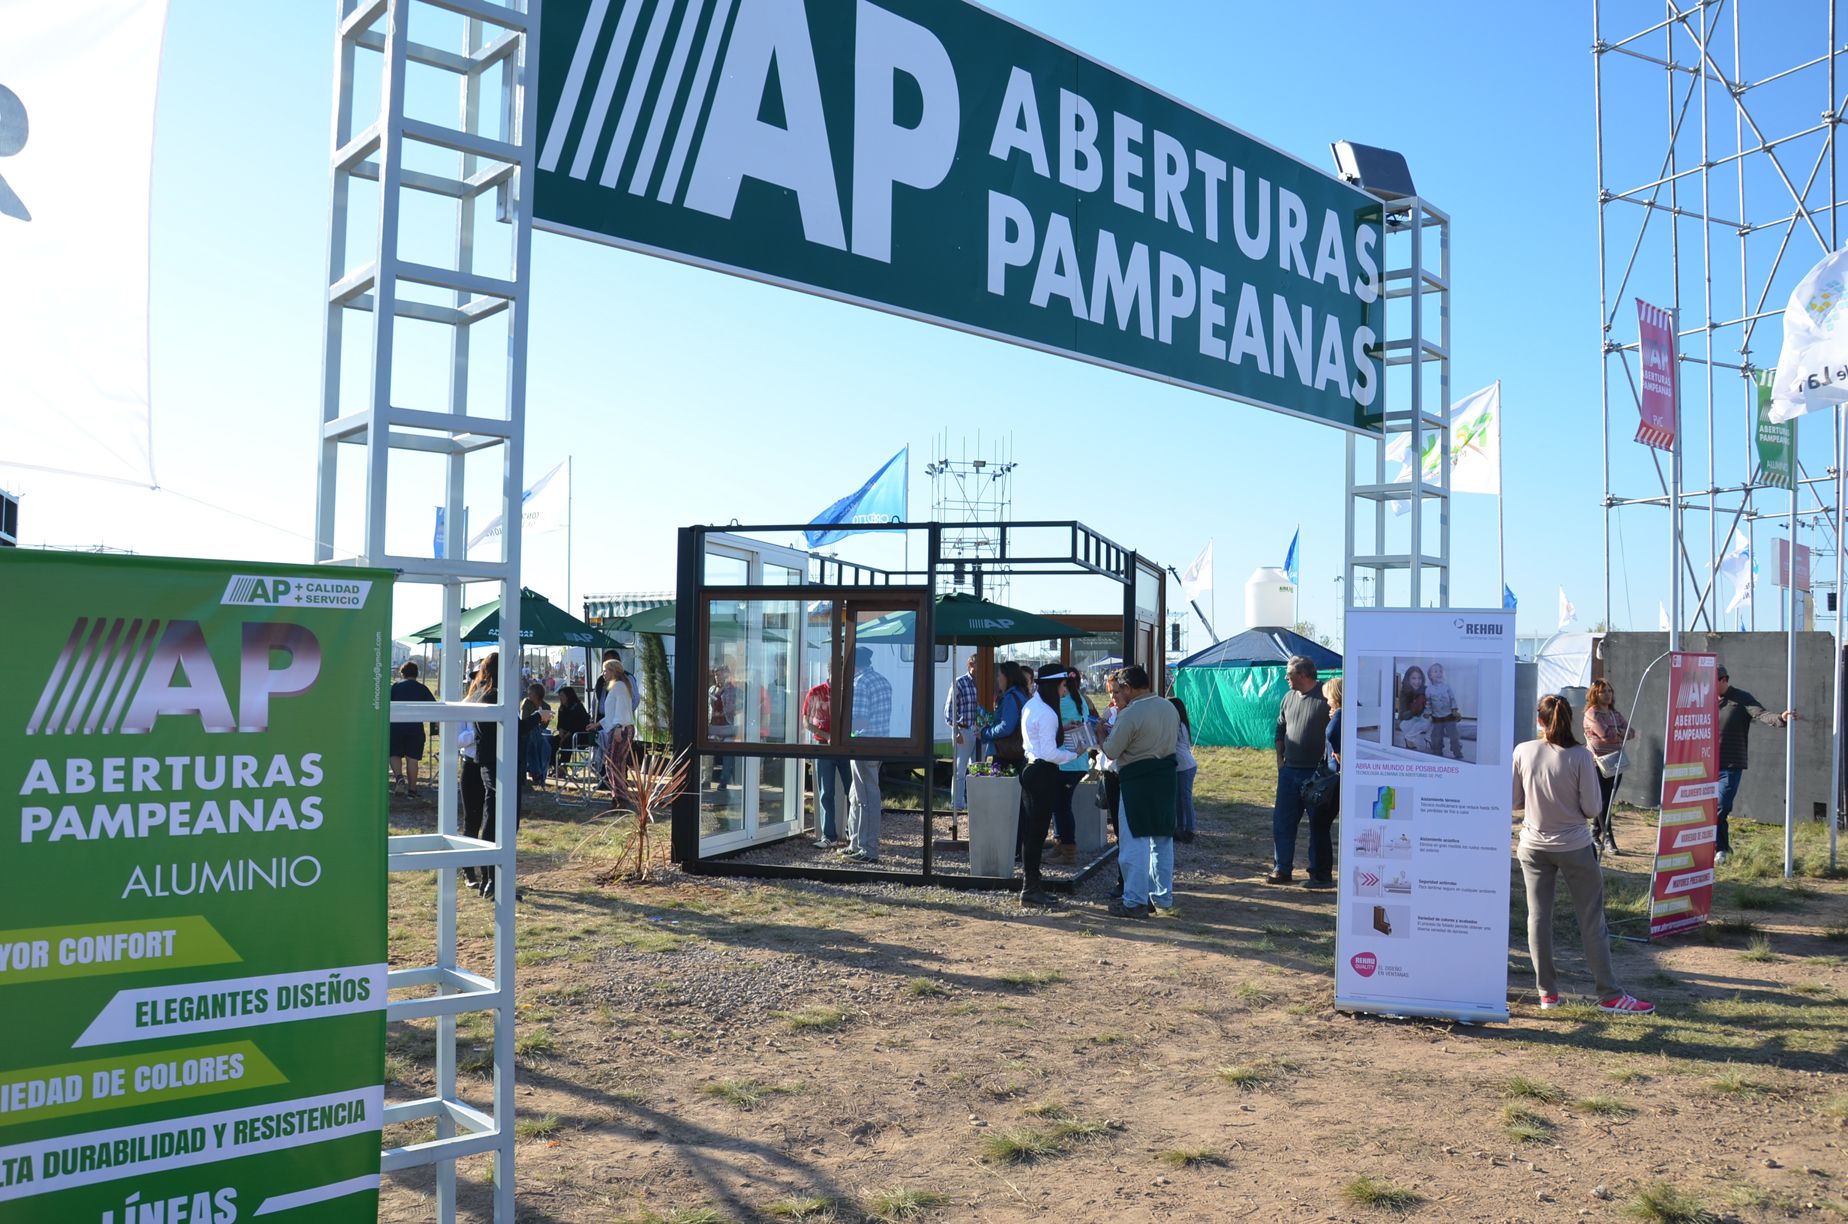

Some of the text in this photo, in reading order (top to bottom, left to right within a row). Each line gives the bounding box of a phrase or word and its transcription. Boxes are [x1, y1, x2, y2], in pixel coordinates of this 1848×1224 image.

[683, 0, 960, 264] AP
[989, 65, 1380, 304] ABERTURAS
[987, 189, 1378, 407] PAMPEANAS
[1643, 380, 1672, 397] AMPEANAS
[248, 578, 291, 604] AP
[305, 594, 360, 605] SERVICIO
[306, 583, 360, 594] CALIDAD
[573, 632, 594, 643] AP
[984, 618, 1015, 630] AP
[1466, 623, 1503, 635] REHAU
[119, 618, 322, 736] AP
[1687, 672, 1710, 708] AP
[1674, 714, 1711, 727] ABERTURAS
[1674, 728, 1711, 741] PAMPEANAS
[1701, 747, 1711, 758] PVC
[19, 752, 325, 796] ABERTURAS
[1415, 765, 1460, 774] POSIBILIDADES
[20, 795, 325, 844] PAMPEANAS
[120, 855, 322, 900] ALUMINIO
[58, 929, 177, 965] CONFORT
[1355, 957, 1376, 965] REHAU
[135, 972, 371, 1028] ELEGANTES DISEÑOS
[1, 1052, 245, 1114] IEDAD DE COLORES
[43, 1127, 206, 1179] DURABILIDAD
[213, 1122, 228, 1149] Y
[233, 1098, 366, 1145] RESISTENCIA
